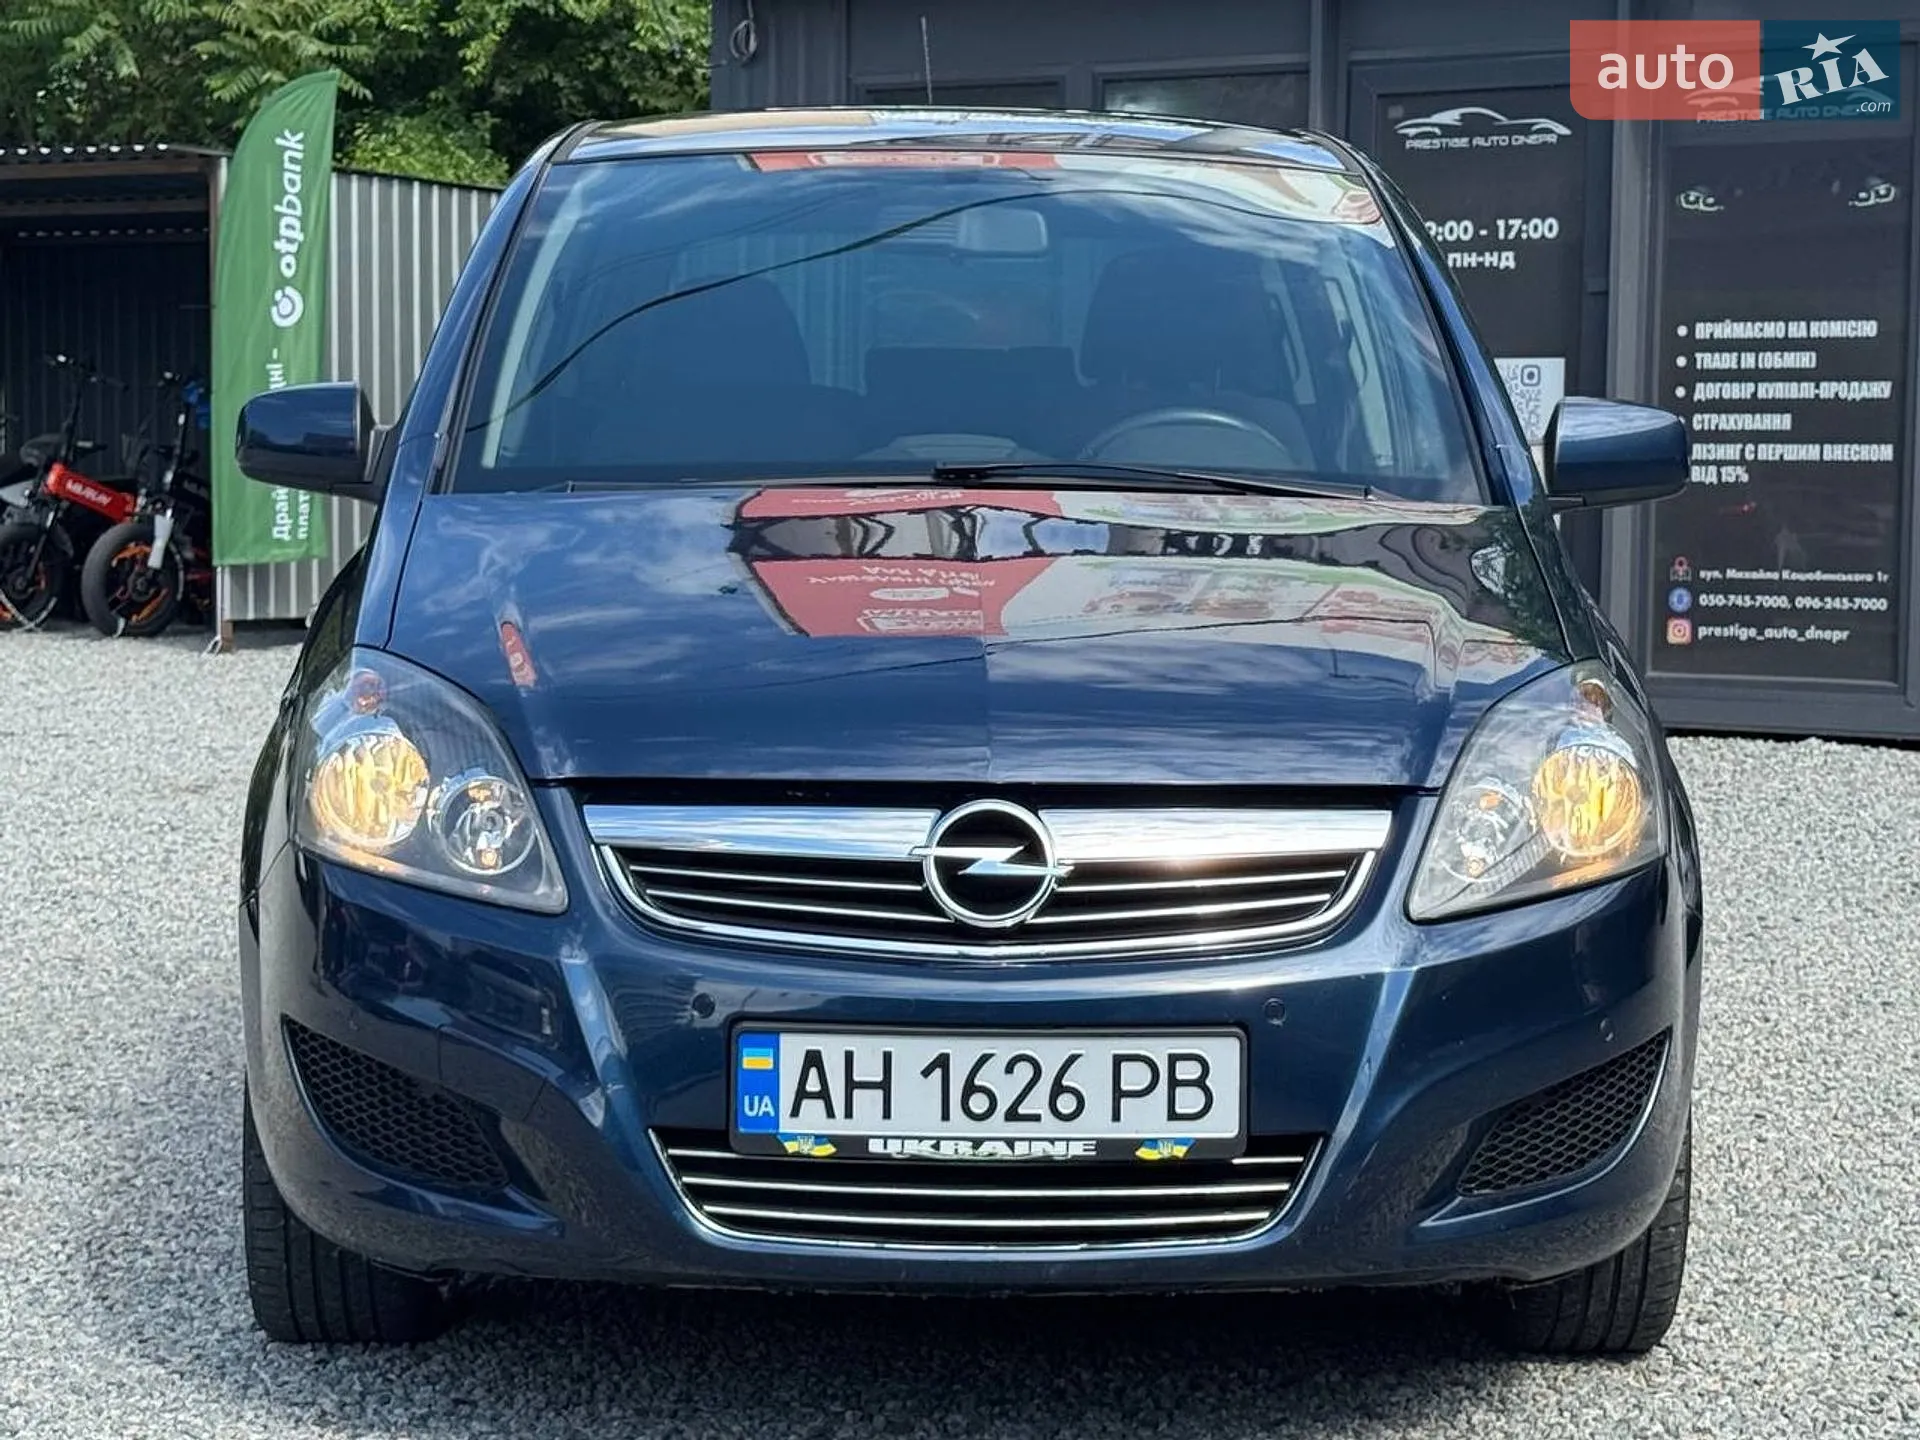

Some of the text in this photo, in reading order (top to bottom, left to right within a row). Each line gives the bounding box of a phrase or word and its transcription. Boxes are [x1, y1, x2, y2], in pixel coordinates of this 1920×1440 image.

[1405, 137, 1470, 150] PRESTIGE
[1472, 135, 1509, 147] AUTO
[274, 128, 304, 278] otpbank
[1496, 217, 1559, 241] 17:00
[1695, 319, 1878, 339] ПРИЙМАЄМО НА КОМІСІЮ
[1694, 351, 1817, 369] TRADE IN (ОБМІН)
[1693, 382, 1755, 402] ДОГОВІР
[1692, 413, 1792, 431] СТРАХУВАННЯ
[1691, 443, 1893, 461] ЛІЗИНГ С ПЕРШИМ ВНЕСКОМ
[1691, 465, 1749, 484] ВІД 15%
[271, 486, 292, 541] Драй
[297, 490, 310, 539] плат
[789, 1049, 1215, 1122] AH 1626 PB
[744, 1095, 774, 1117] UA
[867, 1138, 1098, 1157] UKRAINE
